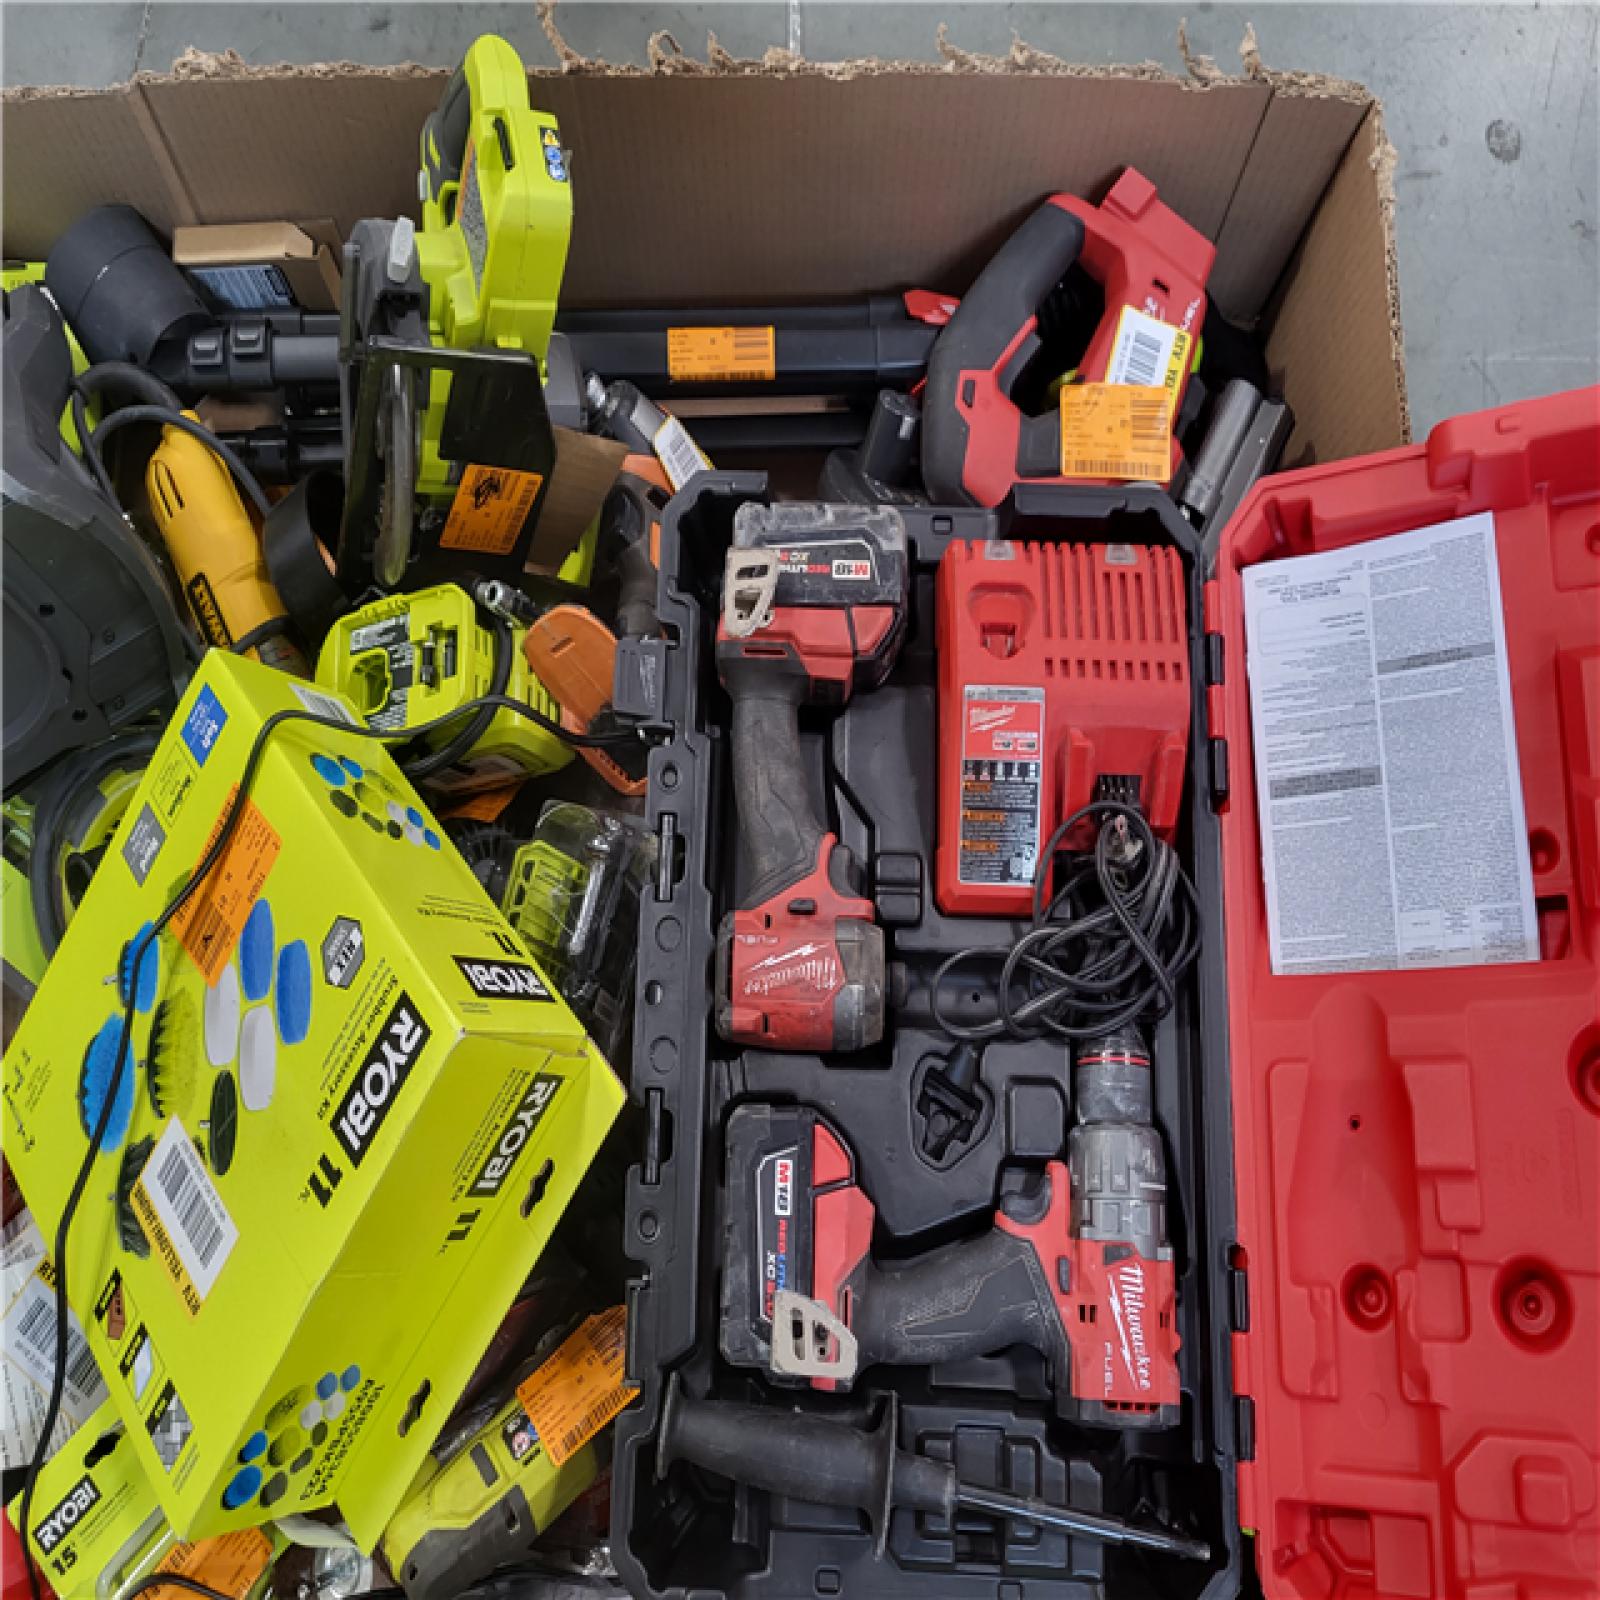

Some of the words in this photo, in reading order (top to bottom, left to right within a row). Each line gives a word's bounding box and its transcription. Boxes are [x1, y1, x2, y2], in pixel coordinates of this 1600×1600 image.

[460, 963, 550, 997] RYOBI
[742, 955, 839, 997] Milwaukee
[339, 1008, 423, 1151] RYOBI
[476, 1079, 557, 1190] RYOBI
[308, 1153, 343, 1208] 11
[776, 1161, 790, 1214] M18
[1119, 1264, 1153, 1391] Milwaukee
[1101, 1341, 1114, 1397] FUEL
[38, 1481, 98, 1549] RYOBI
